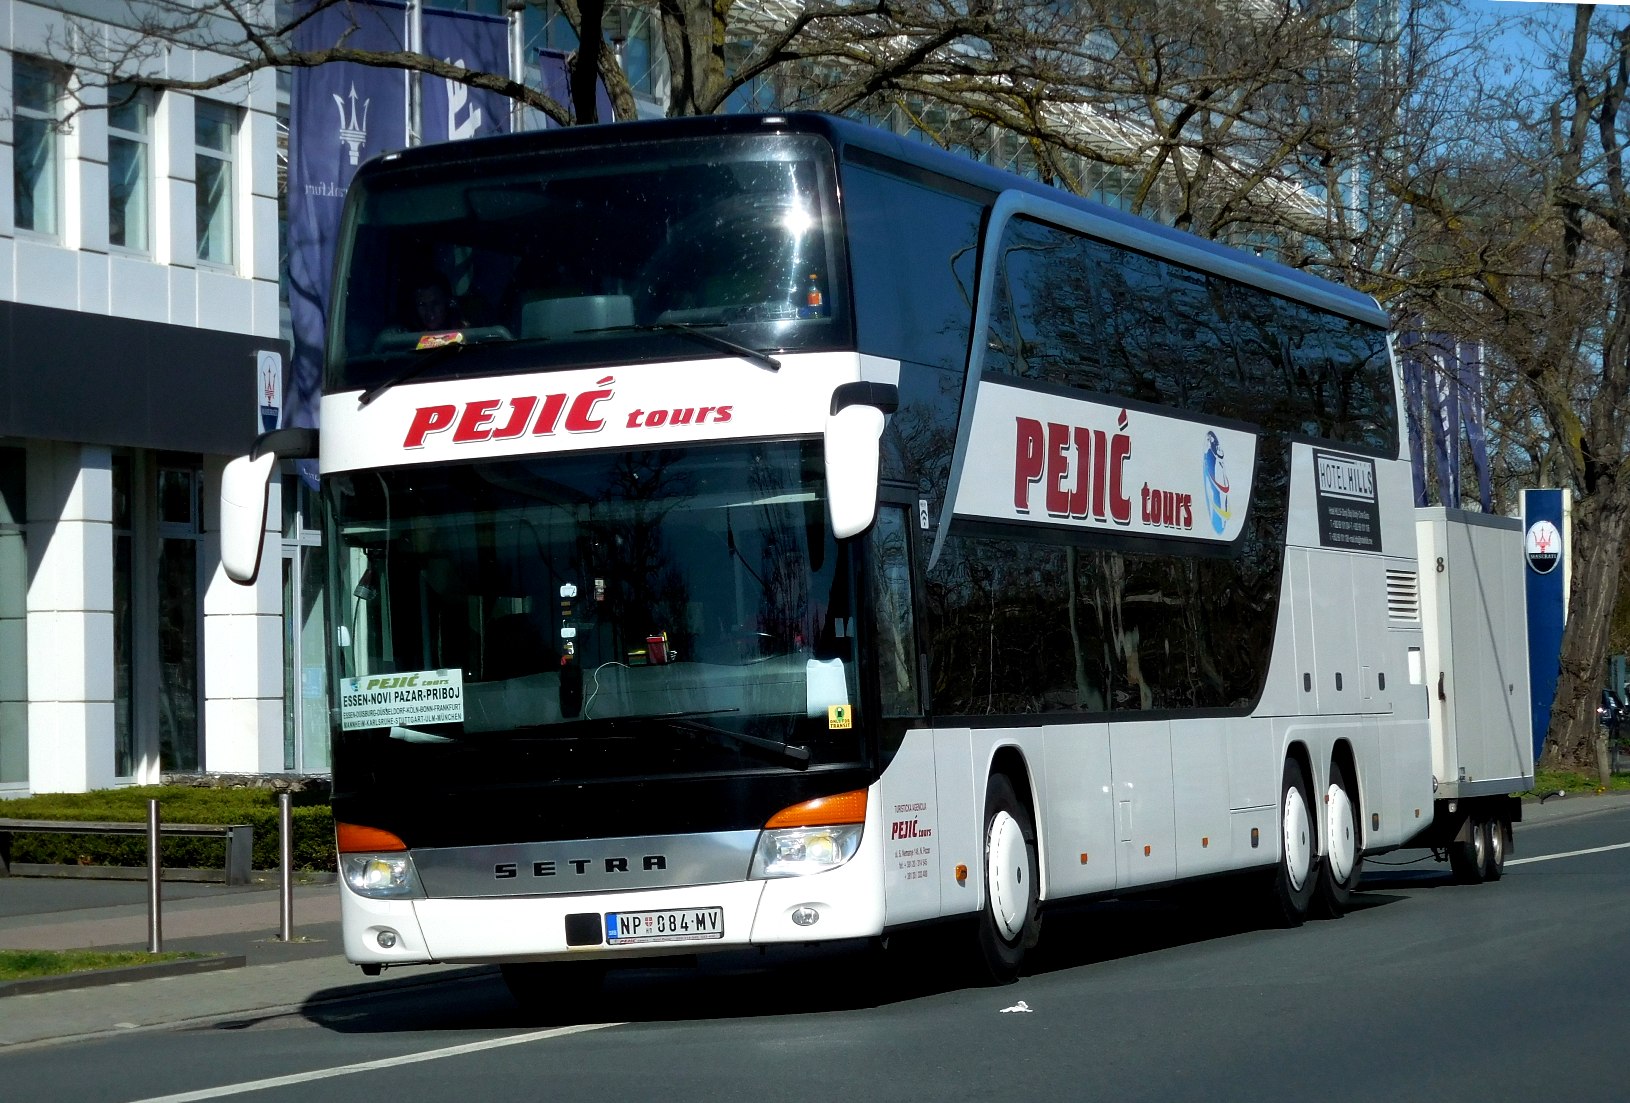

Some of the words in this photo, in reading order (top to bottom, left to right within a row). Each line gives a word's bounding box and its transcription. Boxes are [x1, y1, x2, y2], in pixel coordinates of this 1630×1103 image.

[403, 375, 615, 450] PEJIĆ
[625, 405, 733, 429] tours
[1014, 408, 1132, 525] PEJIĆ
[1141, 482, 1193, 530] tours
[1320, 463, 1347, 490] HOTEL
[1347, 467, 1373, 495] HILLS
[1436, 556, 1445, 573] 8
[367, 673, 419, 690] PEJIĆ
[343, 692, 392, 707] ESSEN-NOVI
[394, 687, 460, 703] PAZAR-PRIBOJ
[891, 814, 918, 840] PEJIĆ
[495, 855, 667, 880] SETRA
[620, 917, 641, 935] NP
